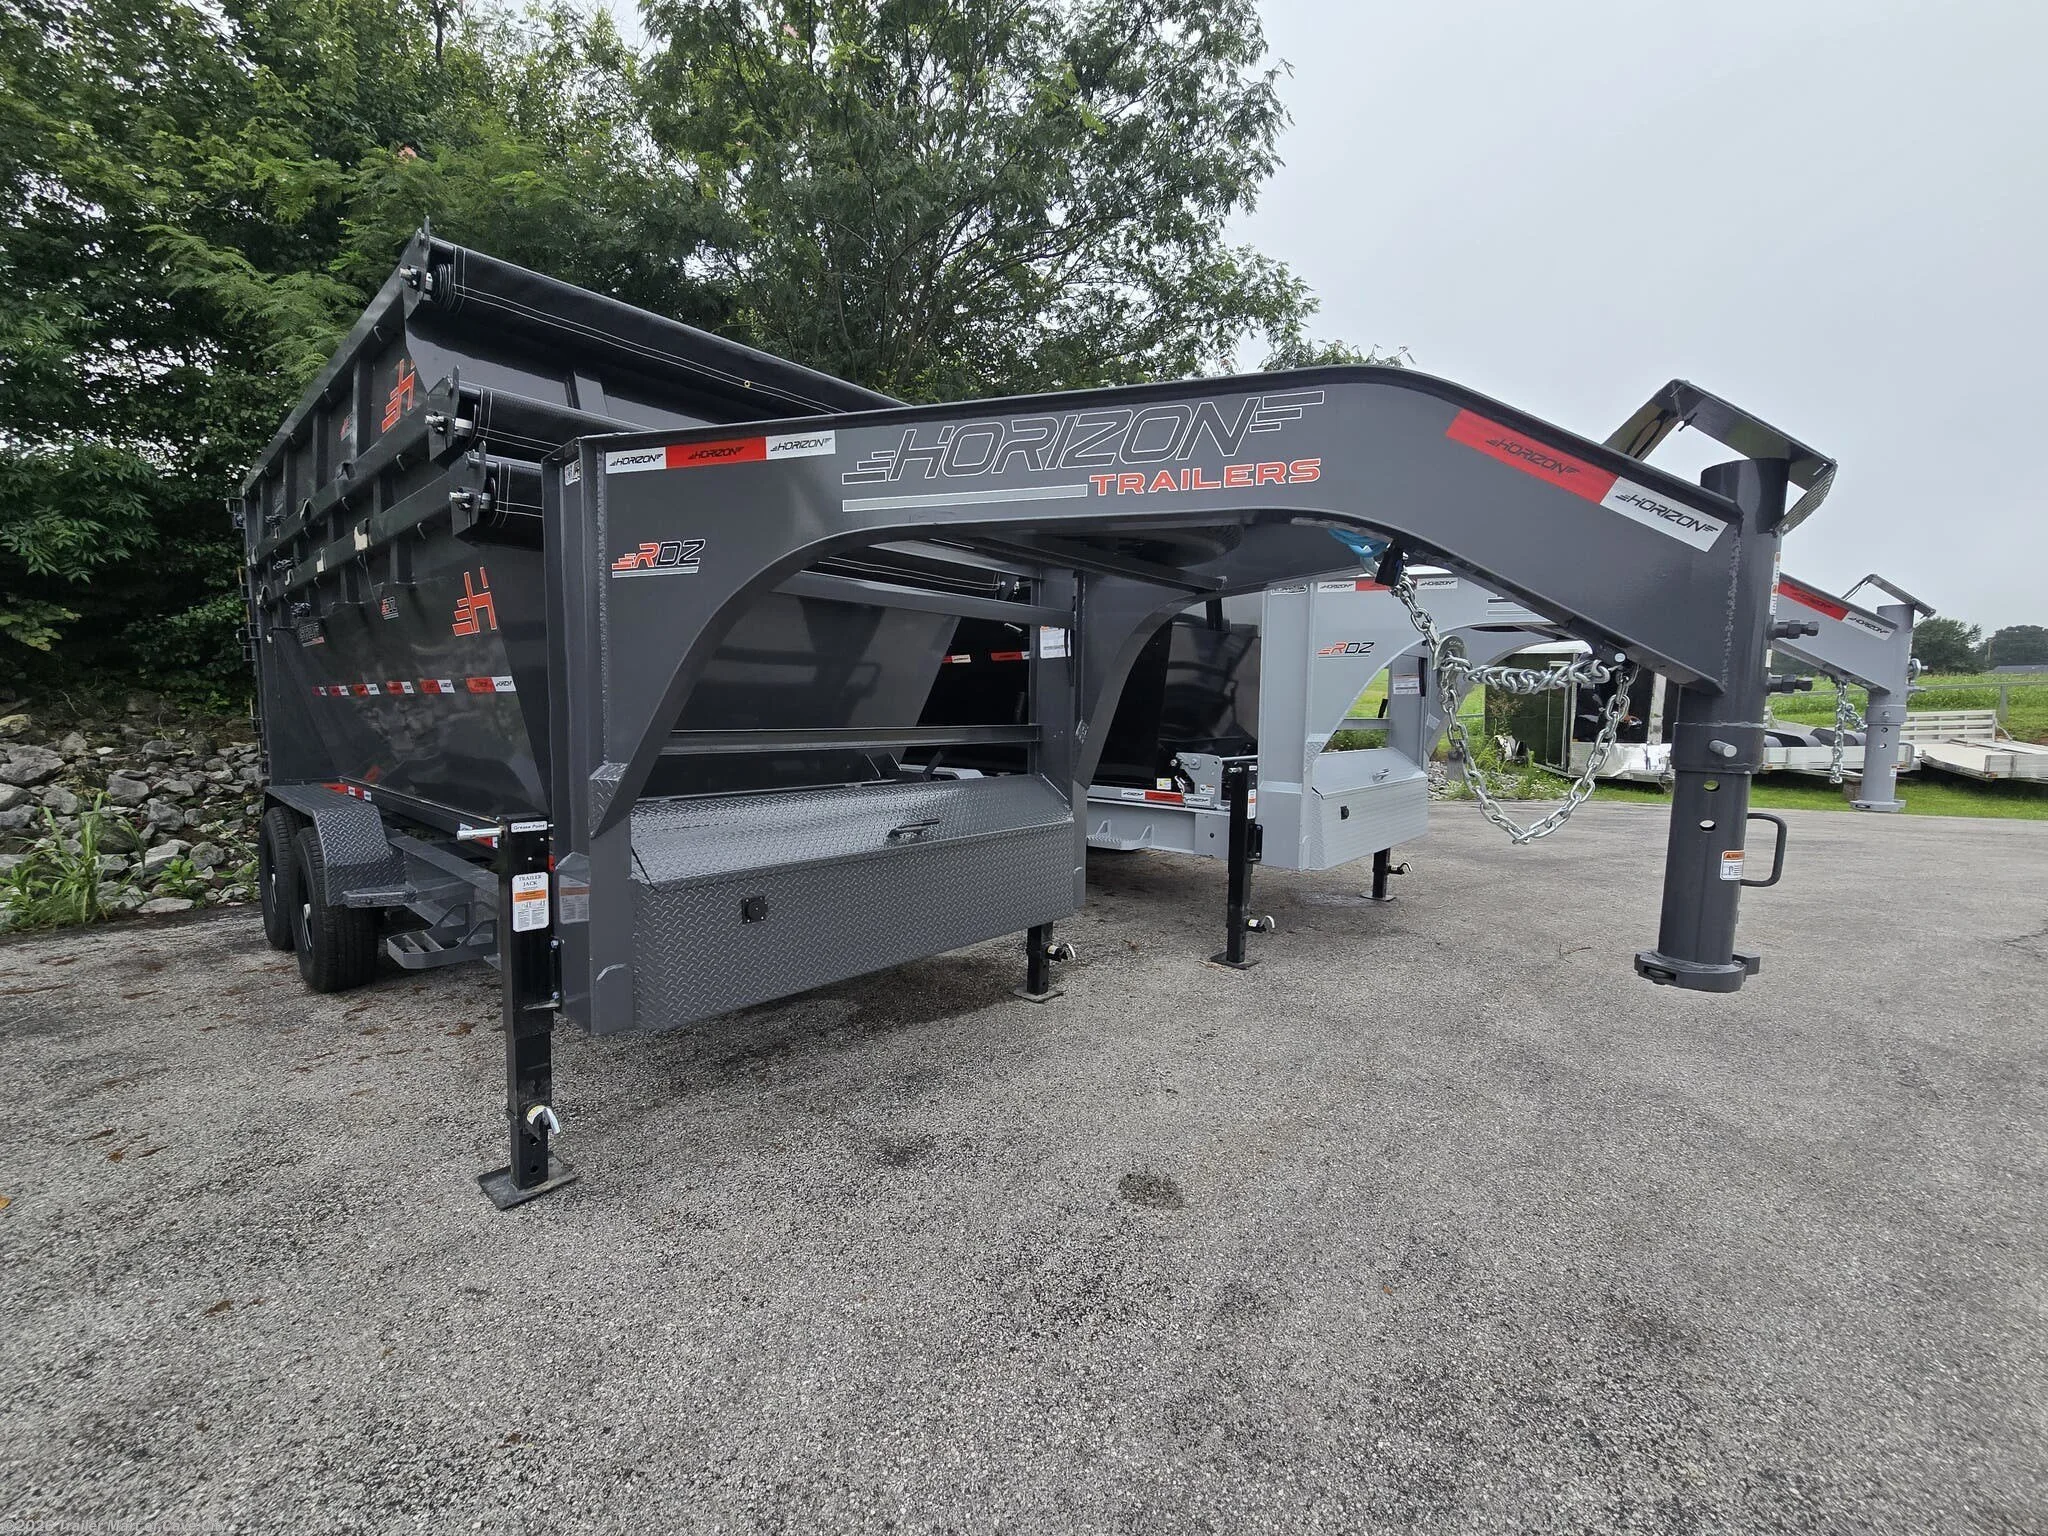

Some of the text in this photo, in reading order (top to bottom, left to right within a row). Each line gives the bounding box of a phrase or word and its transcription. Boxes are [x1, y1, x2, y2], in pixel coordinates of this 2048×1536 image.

[693, 447, 738, 459] HORIZON
[776, 438, 825, 451] HORIZON
[888, 396, 1261, 481] HORIZON
[614, 454, 658, 466] HORIZON
[1494, 437, 1571, 475] HORIZON
[1089, 458, 1322, 497] TRAILERS
[1624, 492, 1709, 534] HORIZON
[629, 538, 706, 569] RDZ
[1329, 641, 1375, 655] RDZ
